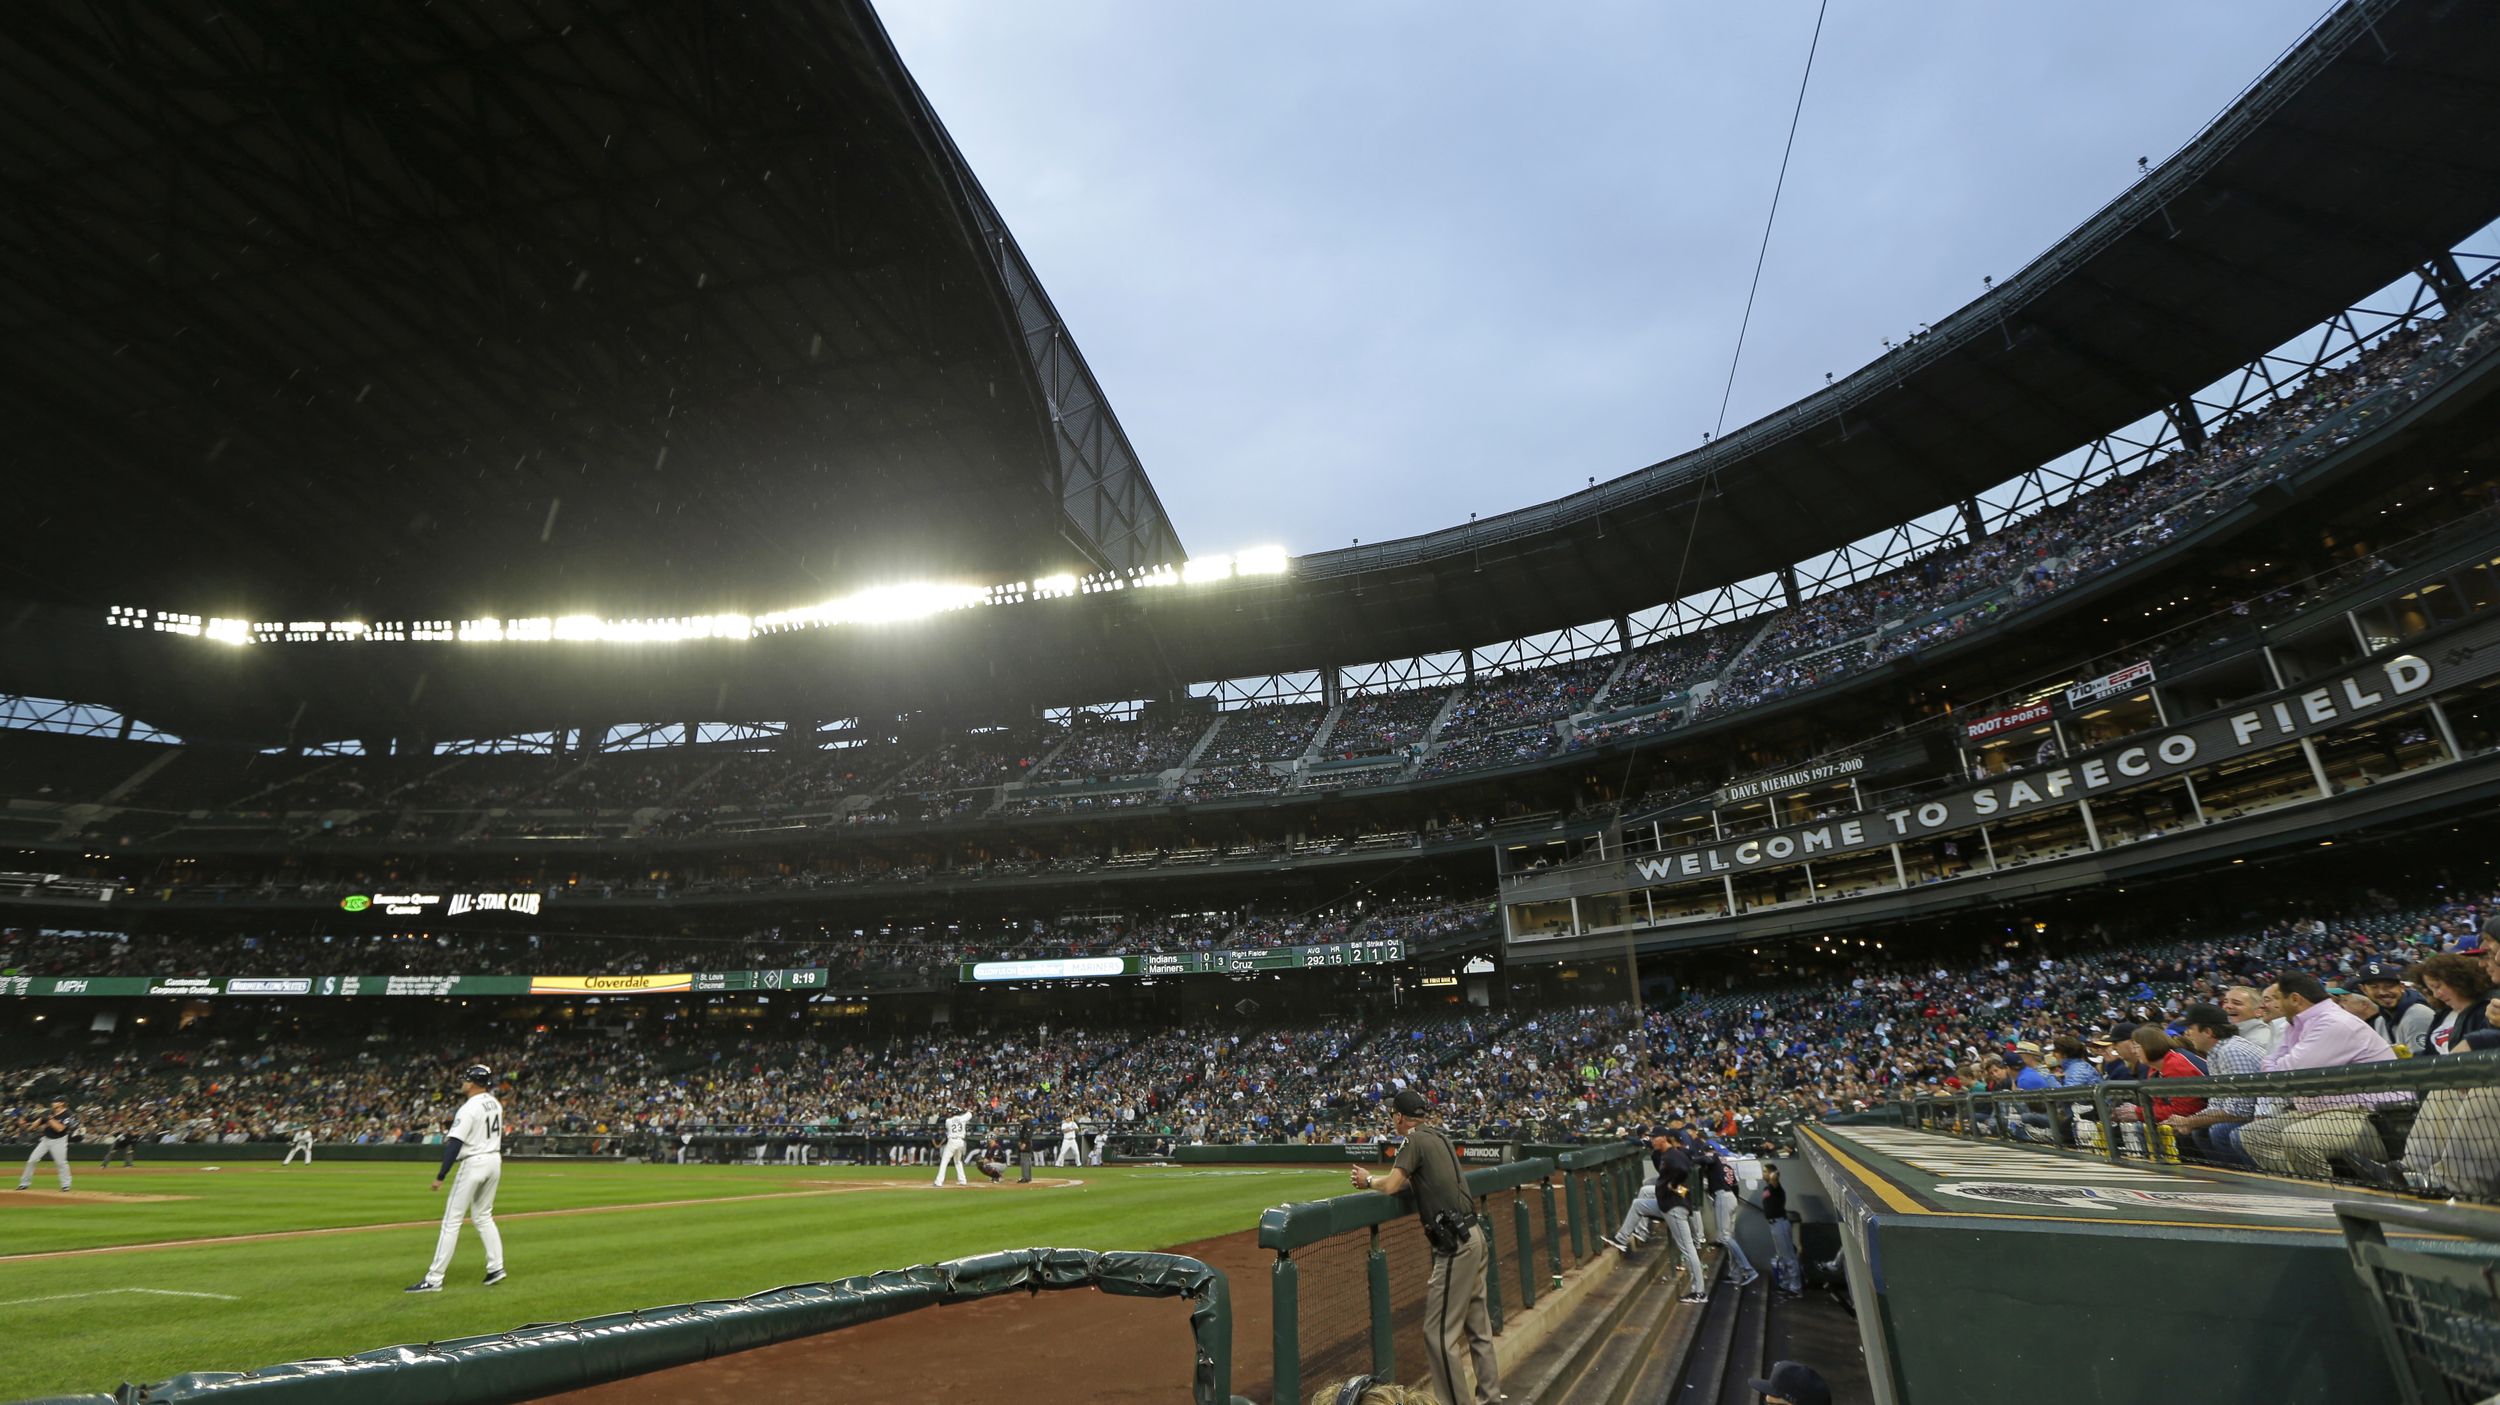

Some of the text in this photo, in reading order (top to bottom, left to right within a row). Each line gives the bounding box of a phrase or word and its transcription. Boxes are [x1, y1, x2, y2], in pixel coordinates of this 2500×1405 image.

[2071, 684, 2092, 699] 710
[2108, 662, 2151, 685] ESPN
[2095, 681, 2132, 699] SEATTLE
[1968, 705, 2049, 737] ROOT SPORTS
[1635, 654, 2431, 881] WELCOME TO SAFECO FIELD
[1730, 784, 1759, 800] DAVE
[1761, 770, 1810, 793] NIEHAUS
[508, 893, 541, 915] CLUB
[1149, 952, 1210, 964] Indians 0
[1217, 957, 1224, 966] 3
[1231, 951, 1247, 959] Right
[1330, 955, 1342, 964] 15
[1353, 949, 1362, 961] 2
[1372, 948, 1378, 960] 1
[1389, 947, 1398, 959] 2
[1149, 964, 1184, 973] Mariners
[1231, 960, 1253, 969] Cruz
[2369, 962, 2380, 975] S
[753, 971, 759, 979] 3
[792, 973, 815, 984] 8:19
[54, 980, 88, 993] MPH
[584, 976, 650, 988] Cloverdale
[485, 1114, 500, 1139] 14
[951, 1123, 963, 1133] 23
